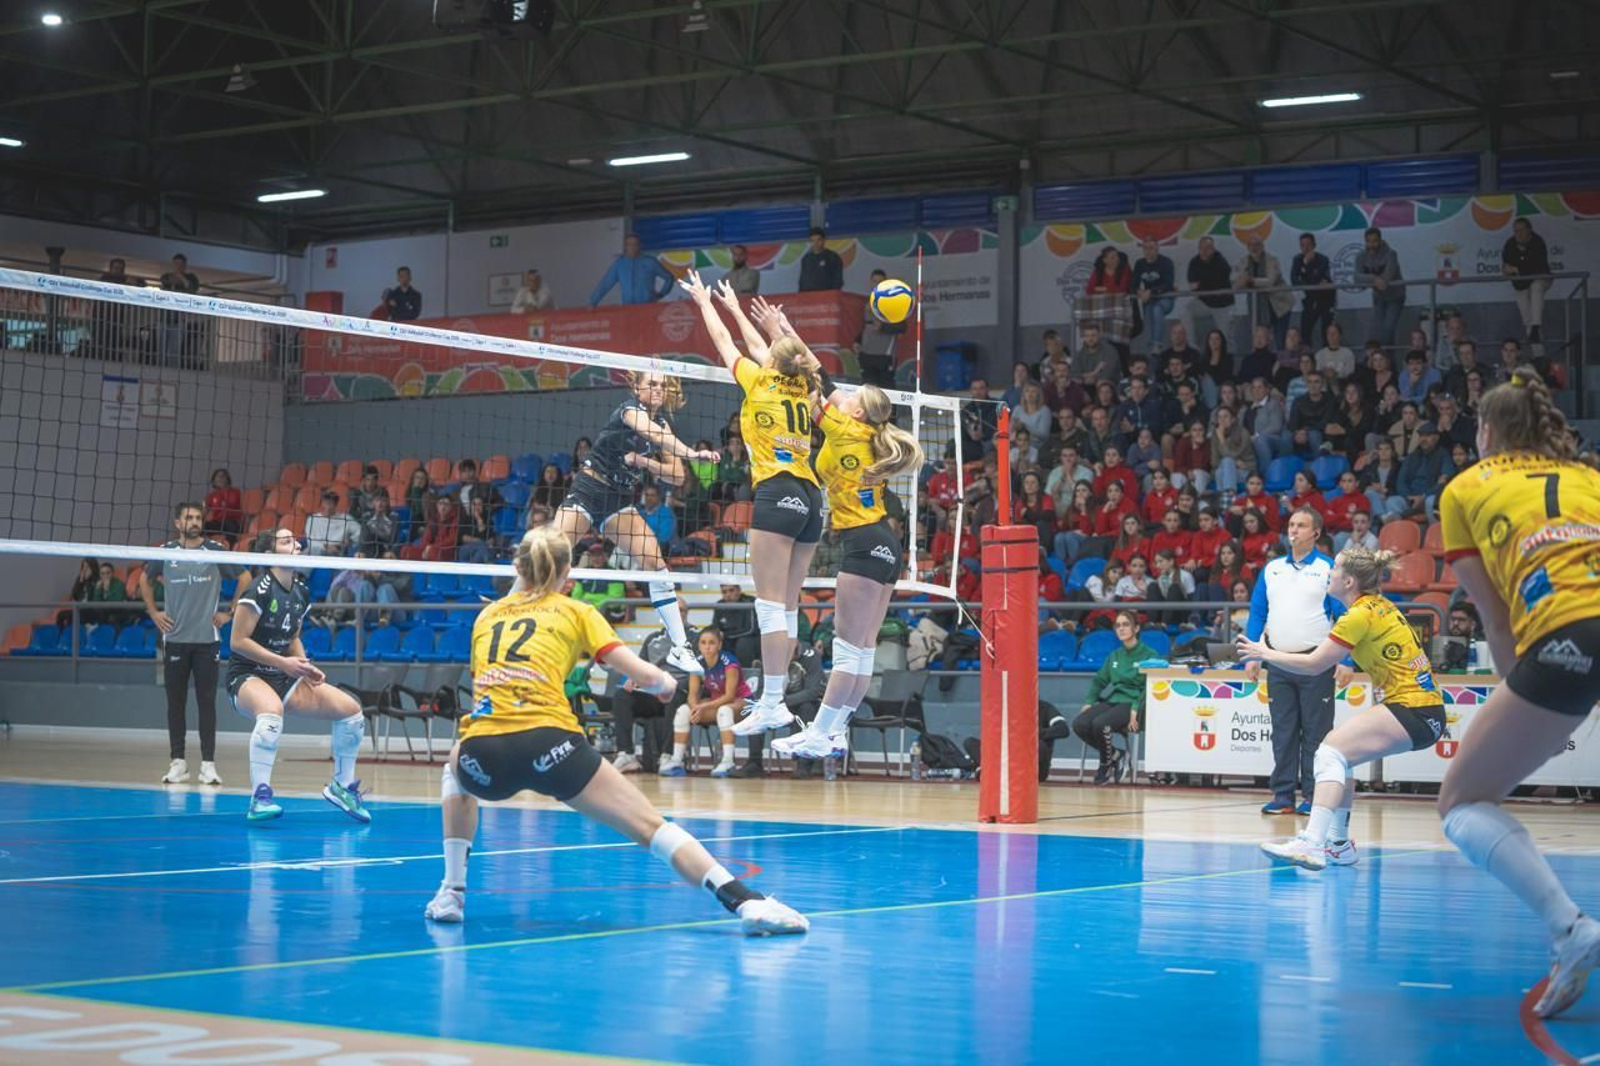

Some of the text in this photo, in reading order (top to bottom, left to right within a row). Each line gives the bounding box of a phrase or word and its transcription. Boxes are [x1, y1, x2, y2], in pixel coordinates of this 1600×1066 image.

[782, 400, 811, 435] 10
[1526, 473, 1560, 518] 7
[282, 613, 291, 632] 4
[488, 618, 537, 664] 12
[1231, 711, 1271, 726] Ayunta
[1231, 728, 1257, 741] Dos
